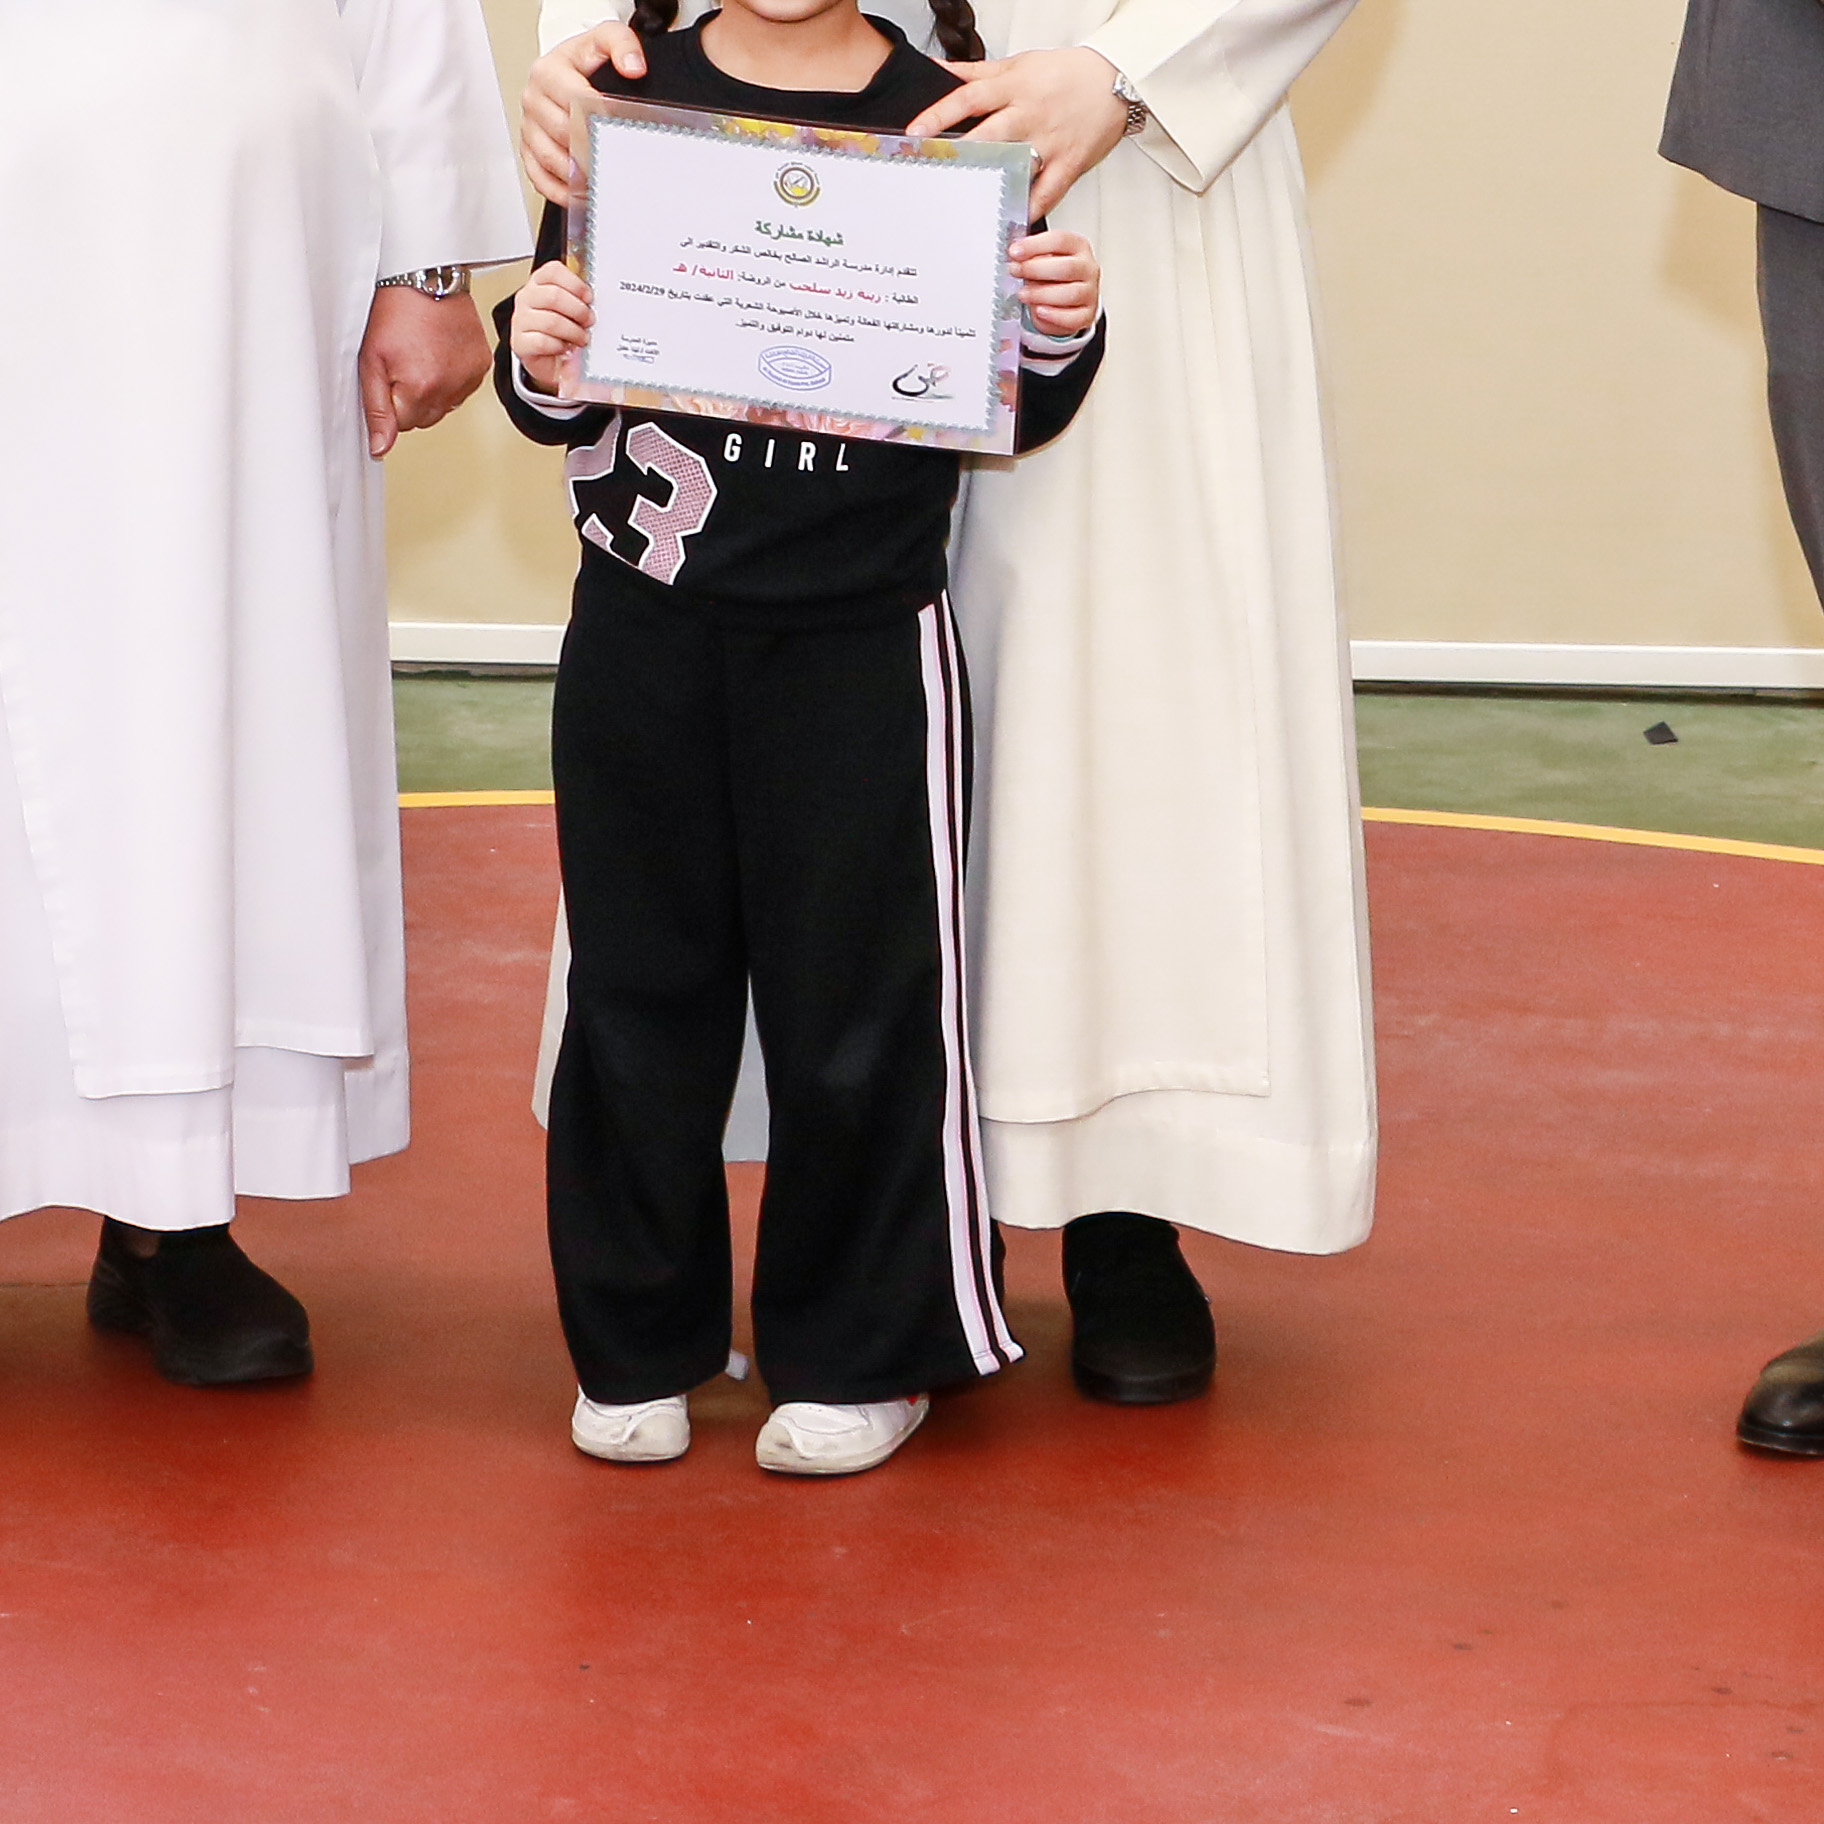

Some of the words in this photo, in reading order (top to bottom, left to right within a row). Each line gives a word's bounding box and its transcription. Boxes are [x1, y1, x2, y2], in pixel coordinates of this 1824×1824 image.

[754, 220, 804, 240] مشاركة
[807, 230, 844, 247] شهادة
[729, 244, 751, 255] الشكر
[754, 249, 783, 261] بخالص
[784, 252, 812, 264] الصالح
[814, 257, 840, 269] الراشد
[842, 258, 872, 272] مدرسة
[875, 263, 895, 276] إدارة
[773, 279, 786, 289] من
[815, 328, 826, 340] لها
[723, 432, 850, 472] GIRL
